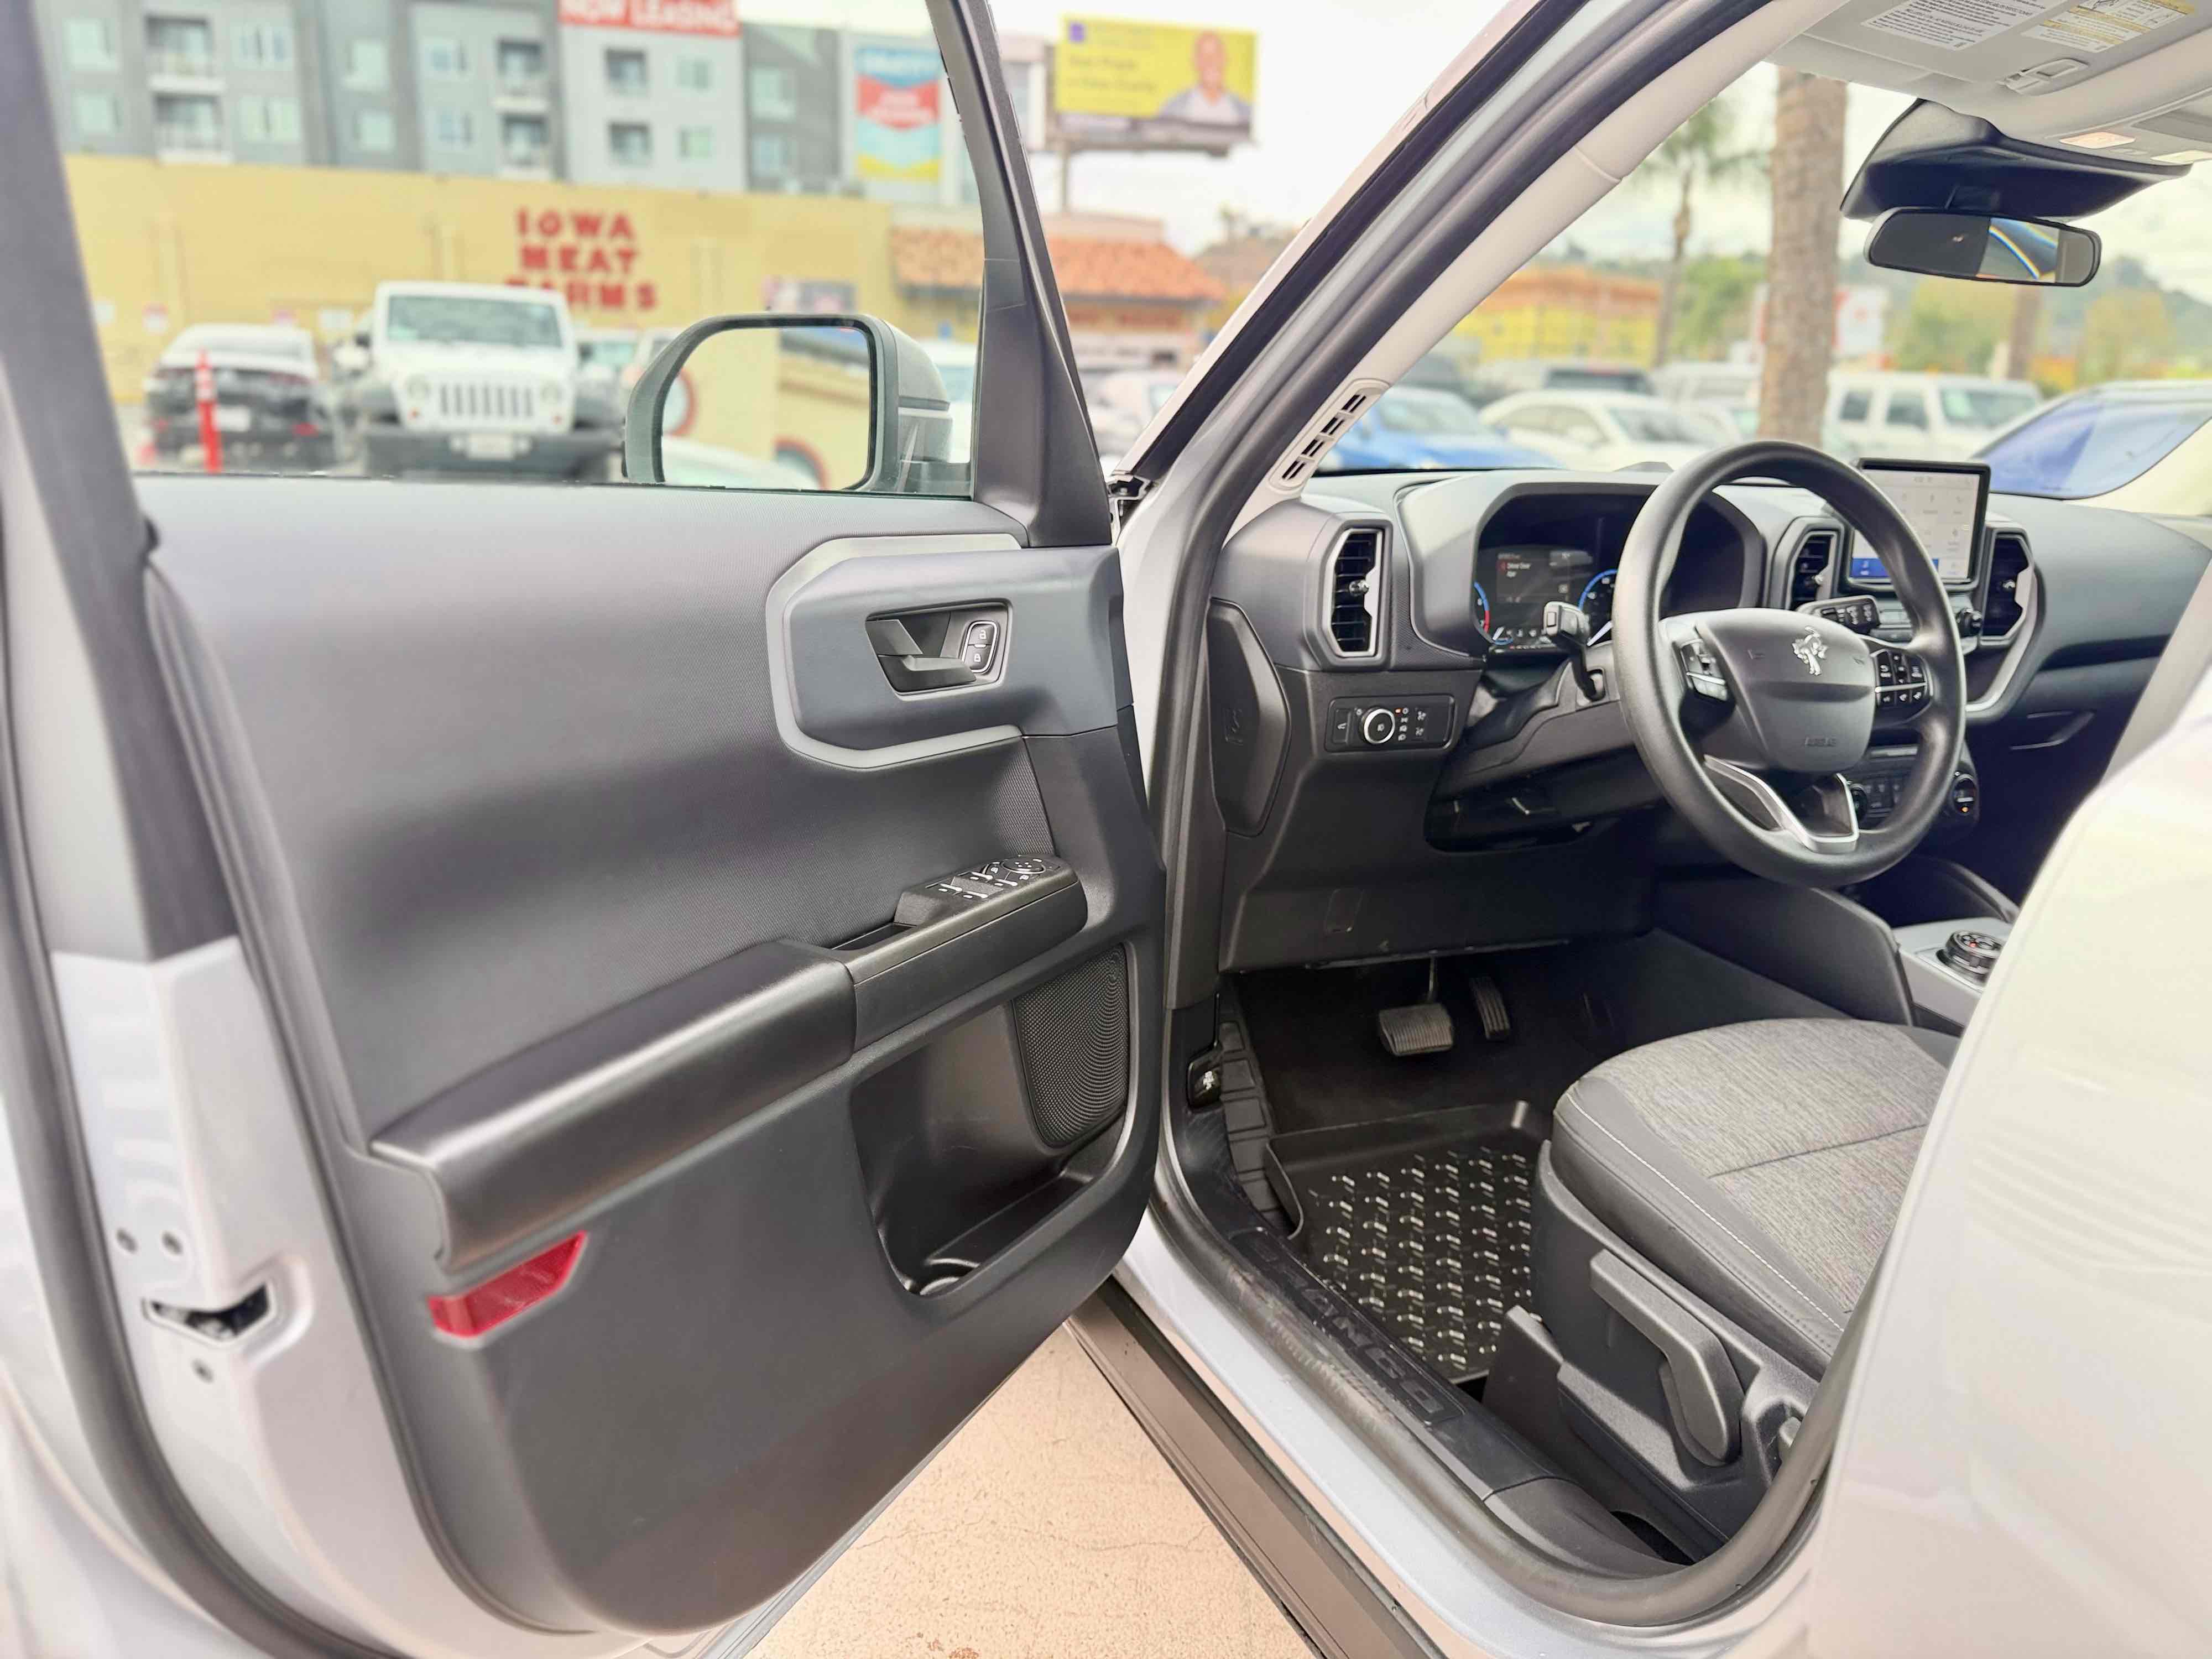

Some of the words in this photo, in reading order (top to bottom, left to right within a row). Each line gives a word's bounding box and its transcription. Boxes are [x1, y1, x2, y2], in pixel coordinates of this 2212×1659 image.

[517, 207, 634, 239] IOWA
[520, 245, 638, 273] MEAT
[504, 276, 656, 310] RMS
